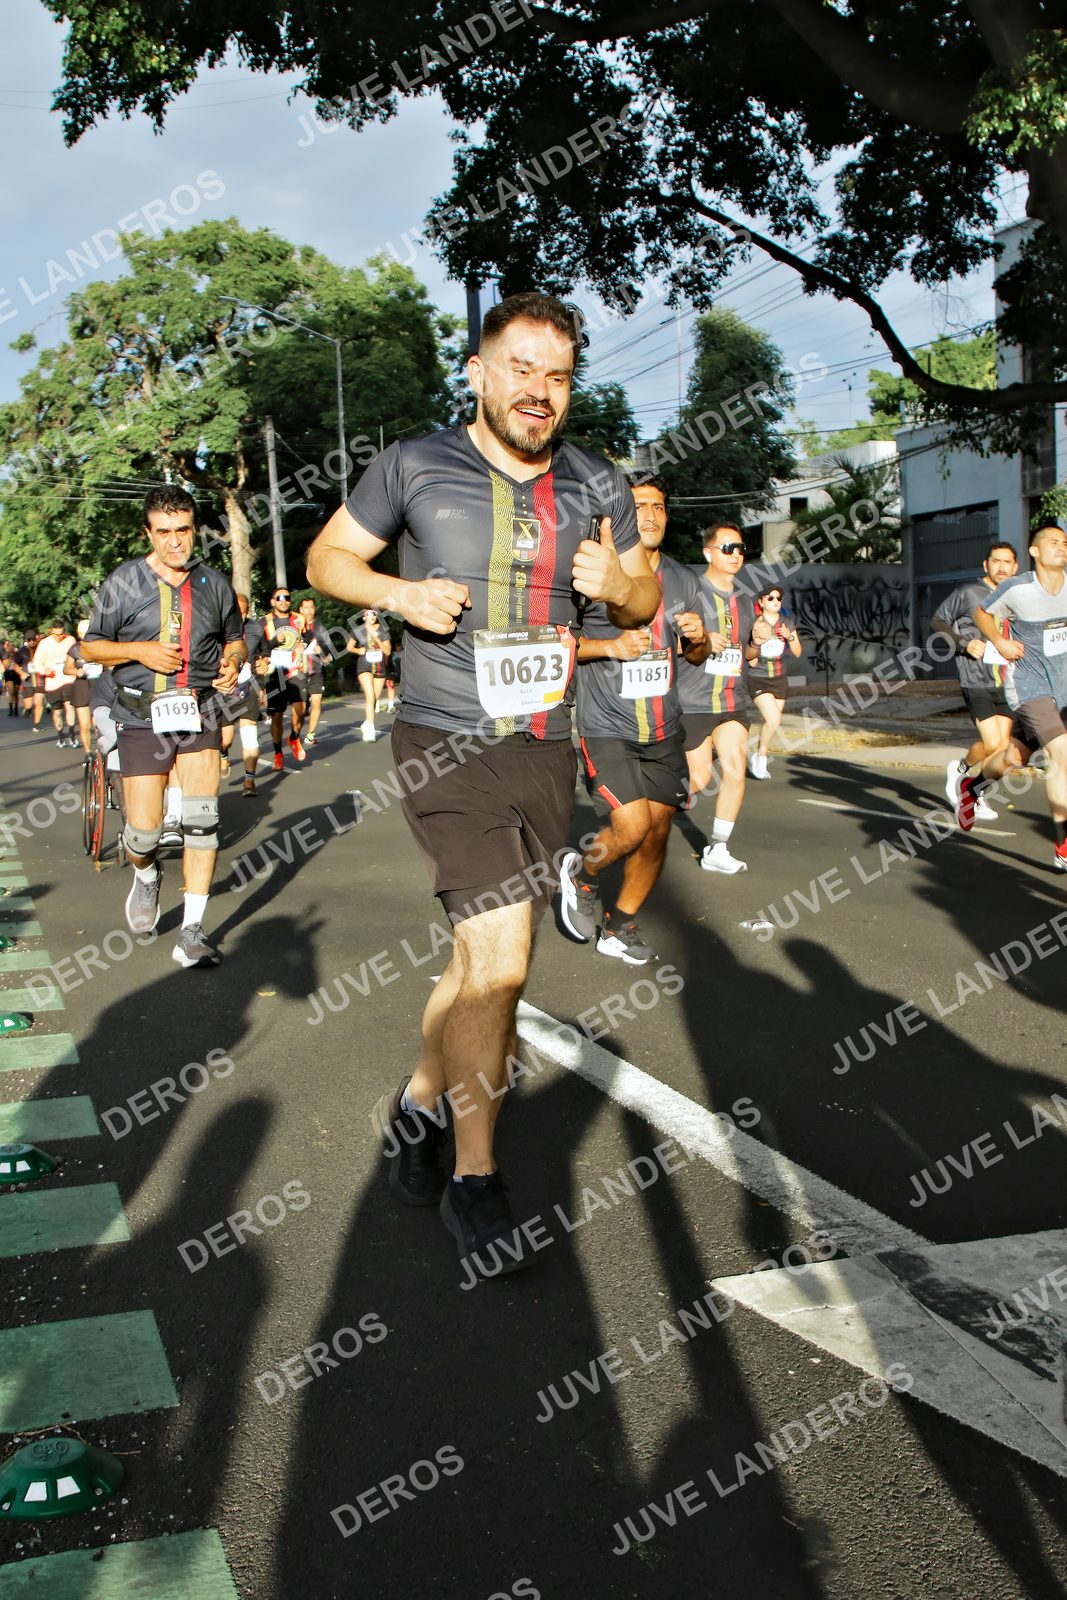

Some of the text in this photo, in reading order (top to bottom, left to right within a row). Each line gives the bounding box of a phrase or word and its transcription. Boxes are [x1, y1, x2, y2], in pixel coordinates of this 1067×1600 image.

[714, 652, 740, 665] 2517
[483, 654, 563, 686] 10623
[626, 666, 668, 682] 11851
[155, 702, 197, 717] 11695
